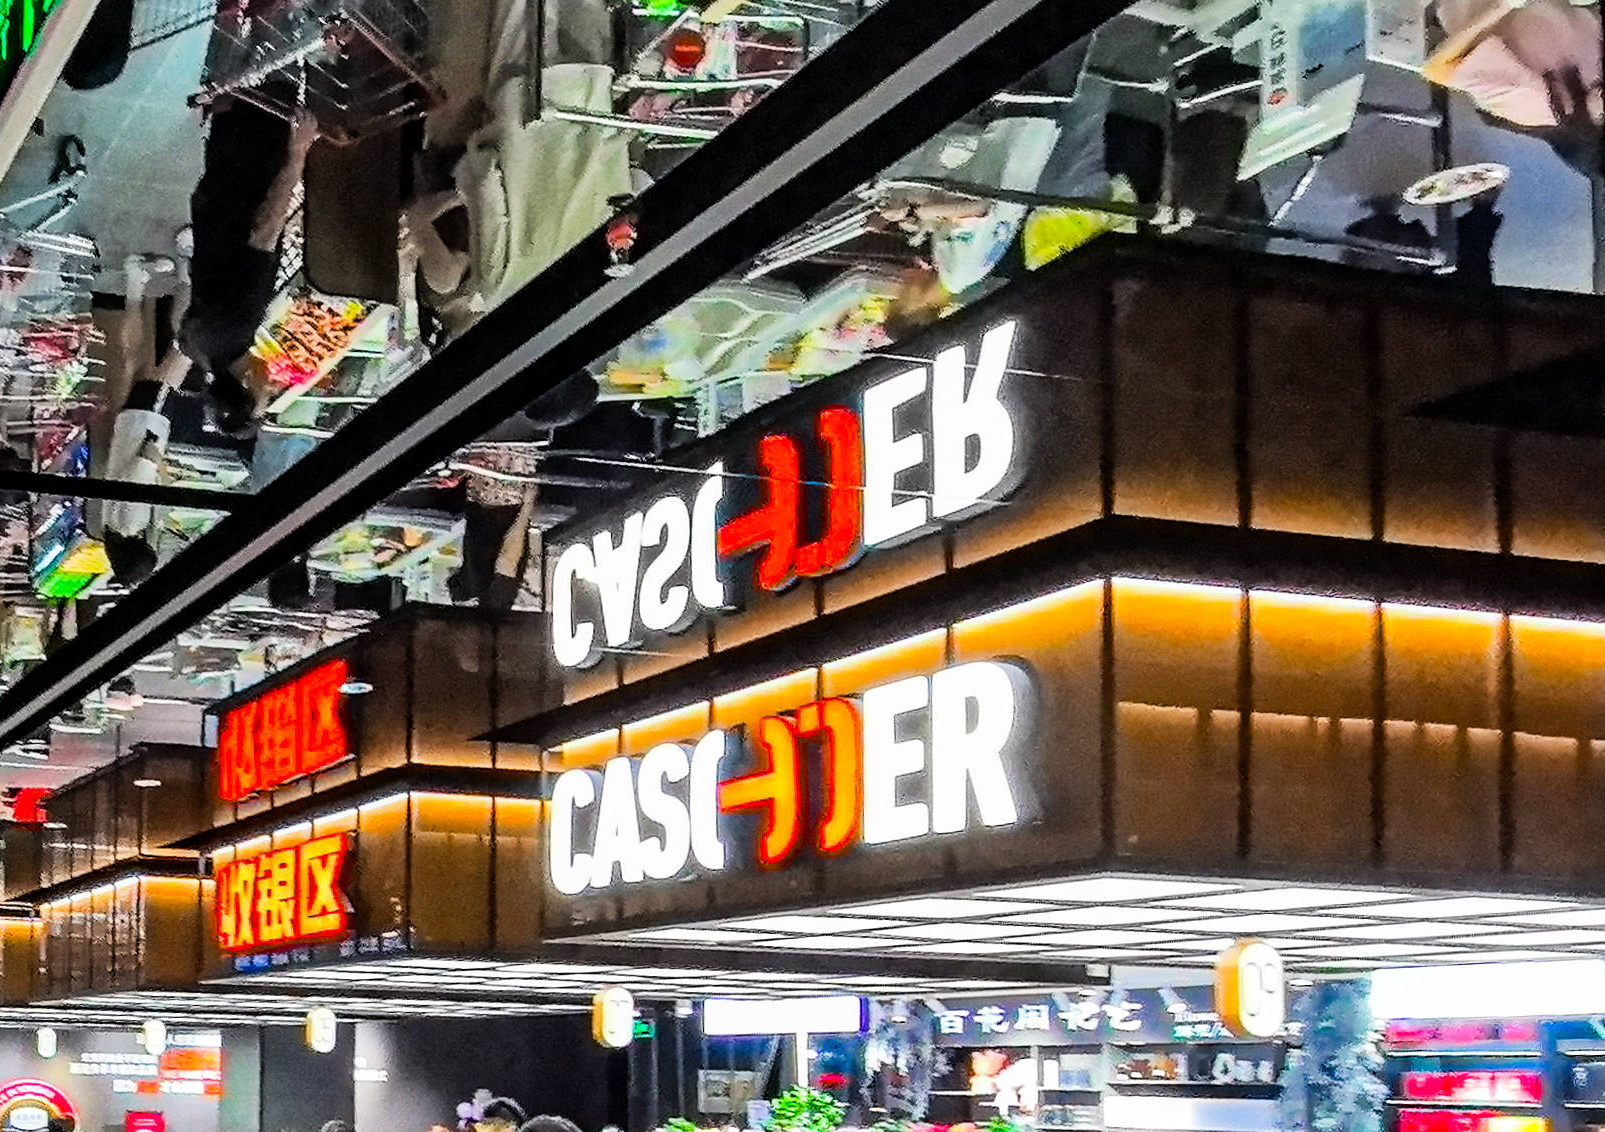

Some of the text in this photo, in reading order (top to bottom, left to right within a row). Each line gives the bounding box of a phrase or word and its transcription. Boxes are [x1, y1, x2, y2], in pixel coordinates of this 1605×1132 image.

[550, 661, 1018, 896] CASHIER
[219, 832, 347, 950] 收银区
